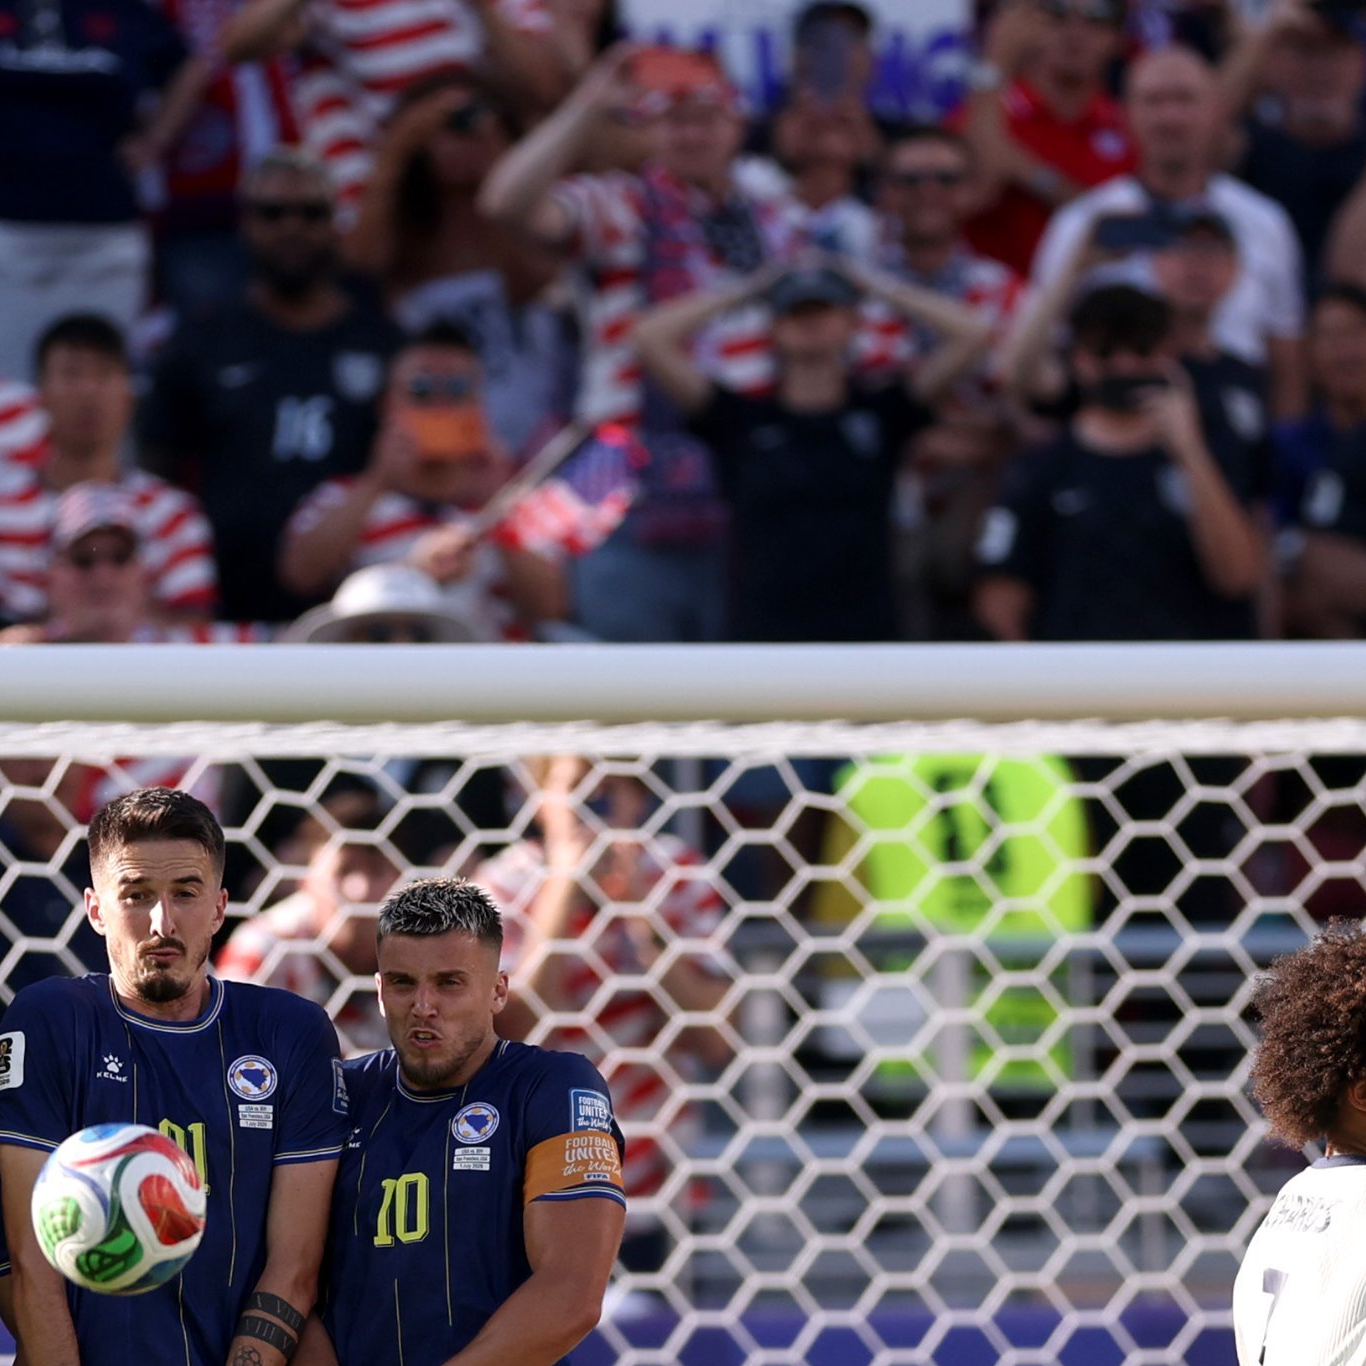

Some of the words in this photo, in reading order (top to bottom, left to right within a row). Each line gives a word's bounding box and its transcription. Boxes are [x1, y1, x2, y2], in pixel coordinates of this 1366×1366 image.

[96, 1071, 128, 1083] KELME
[564, 1145, 619, 1163] UNITES
[561, 1162, 586, 1177] the
[373, 1172, 430, 1248] 10
